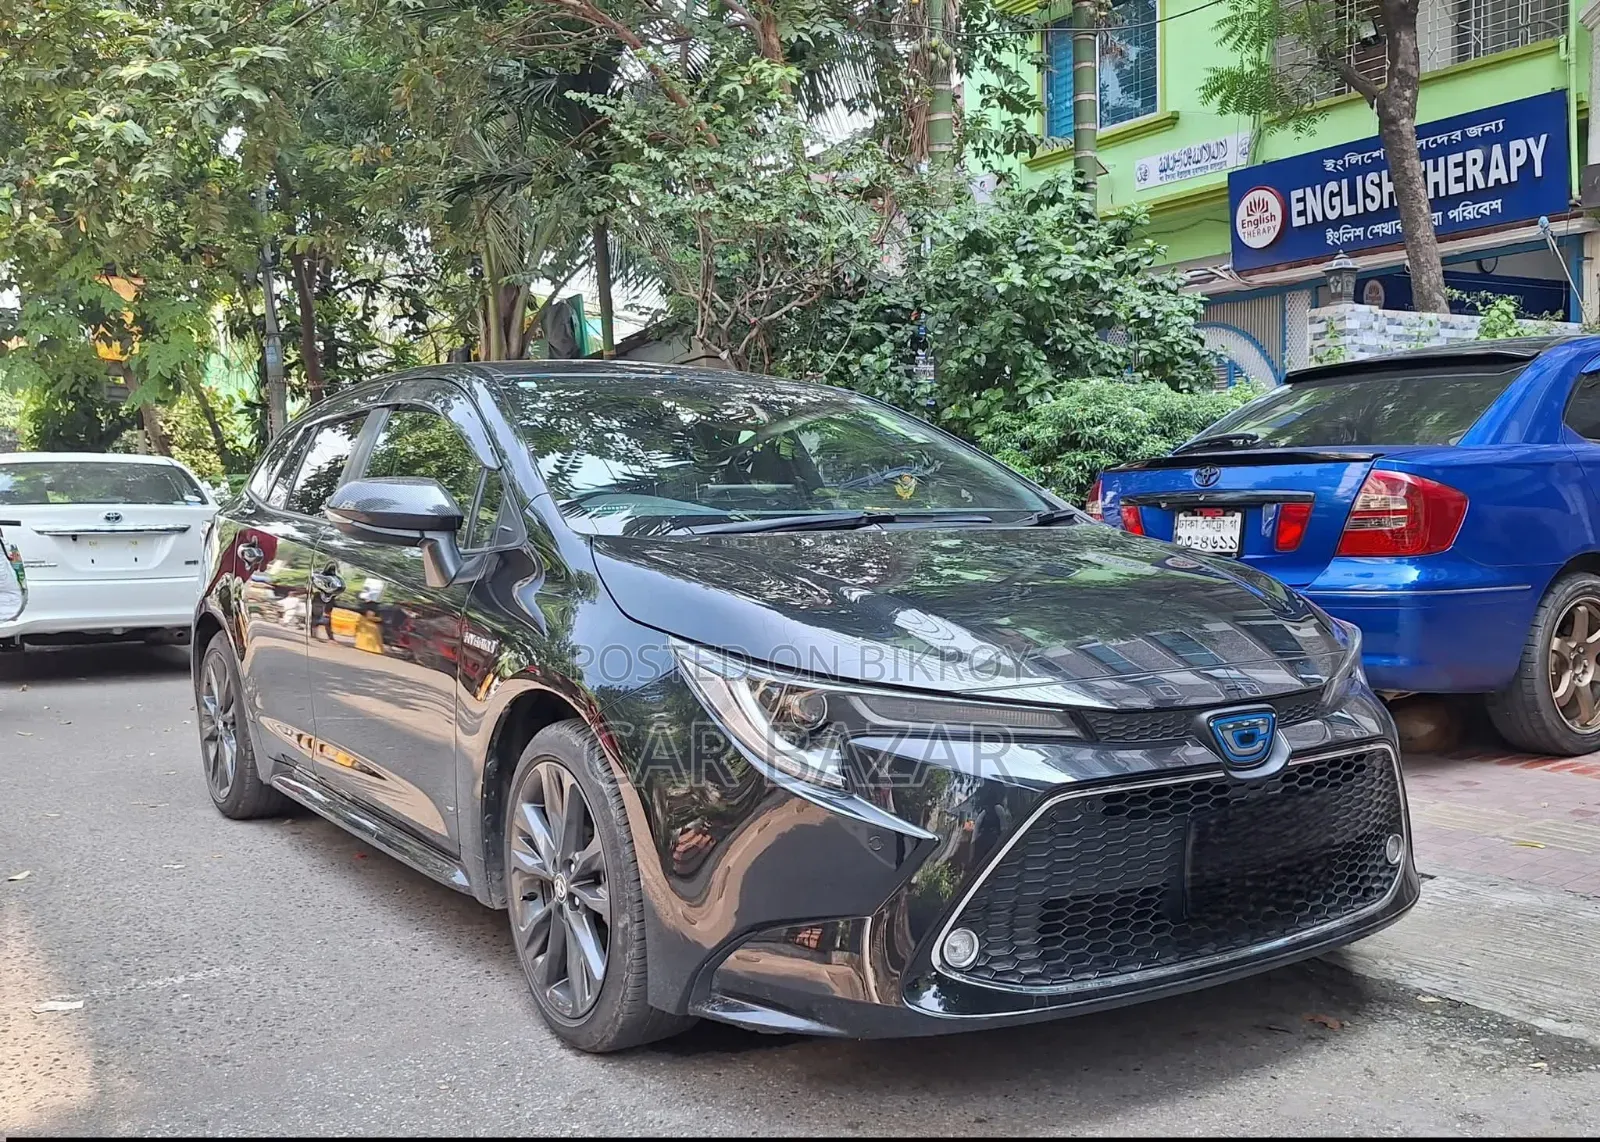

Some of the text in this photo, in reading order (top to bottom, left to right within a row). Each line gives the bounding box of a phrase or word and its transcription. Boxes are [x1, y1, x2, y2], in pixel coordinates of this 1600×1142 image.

[1464, 118, 1506, 139] জন্য
[1290, 134, 1548, 228] ENGLISH HERAPY
[1241, 212, 1276, 229] English
[1325, 224, 1364, 246] ইংলিশ
[1447, 199, 1502, 224] পরিবেশ
[1242, 225, 1277, 240] THERAPY
